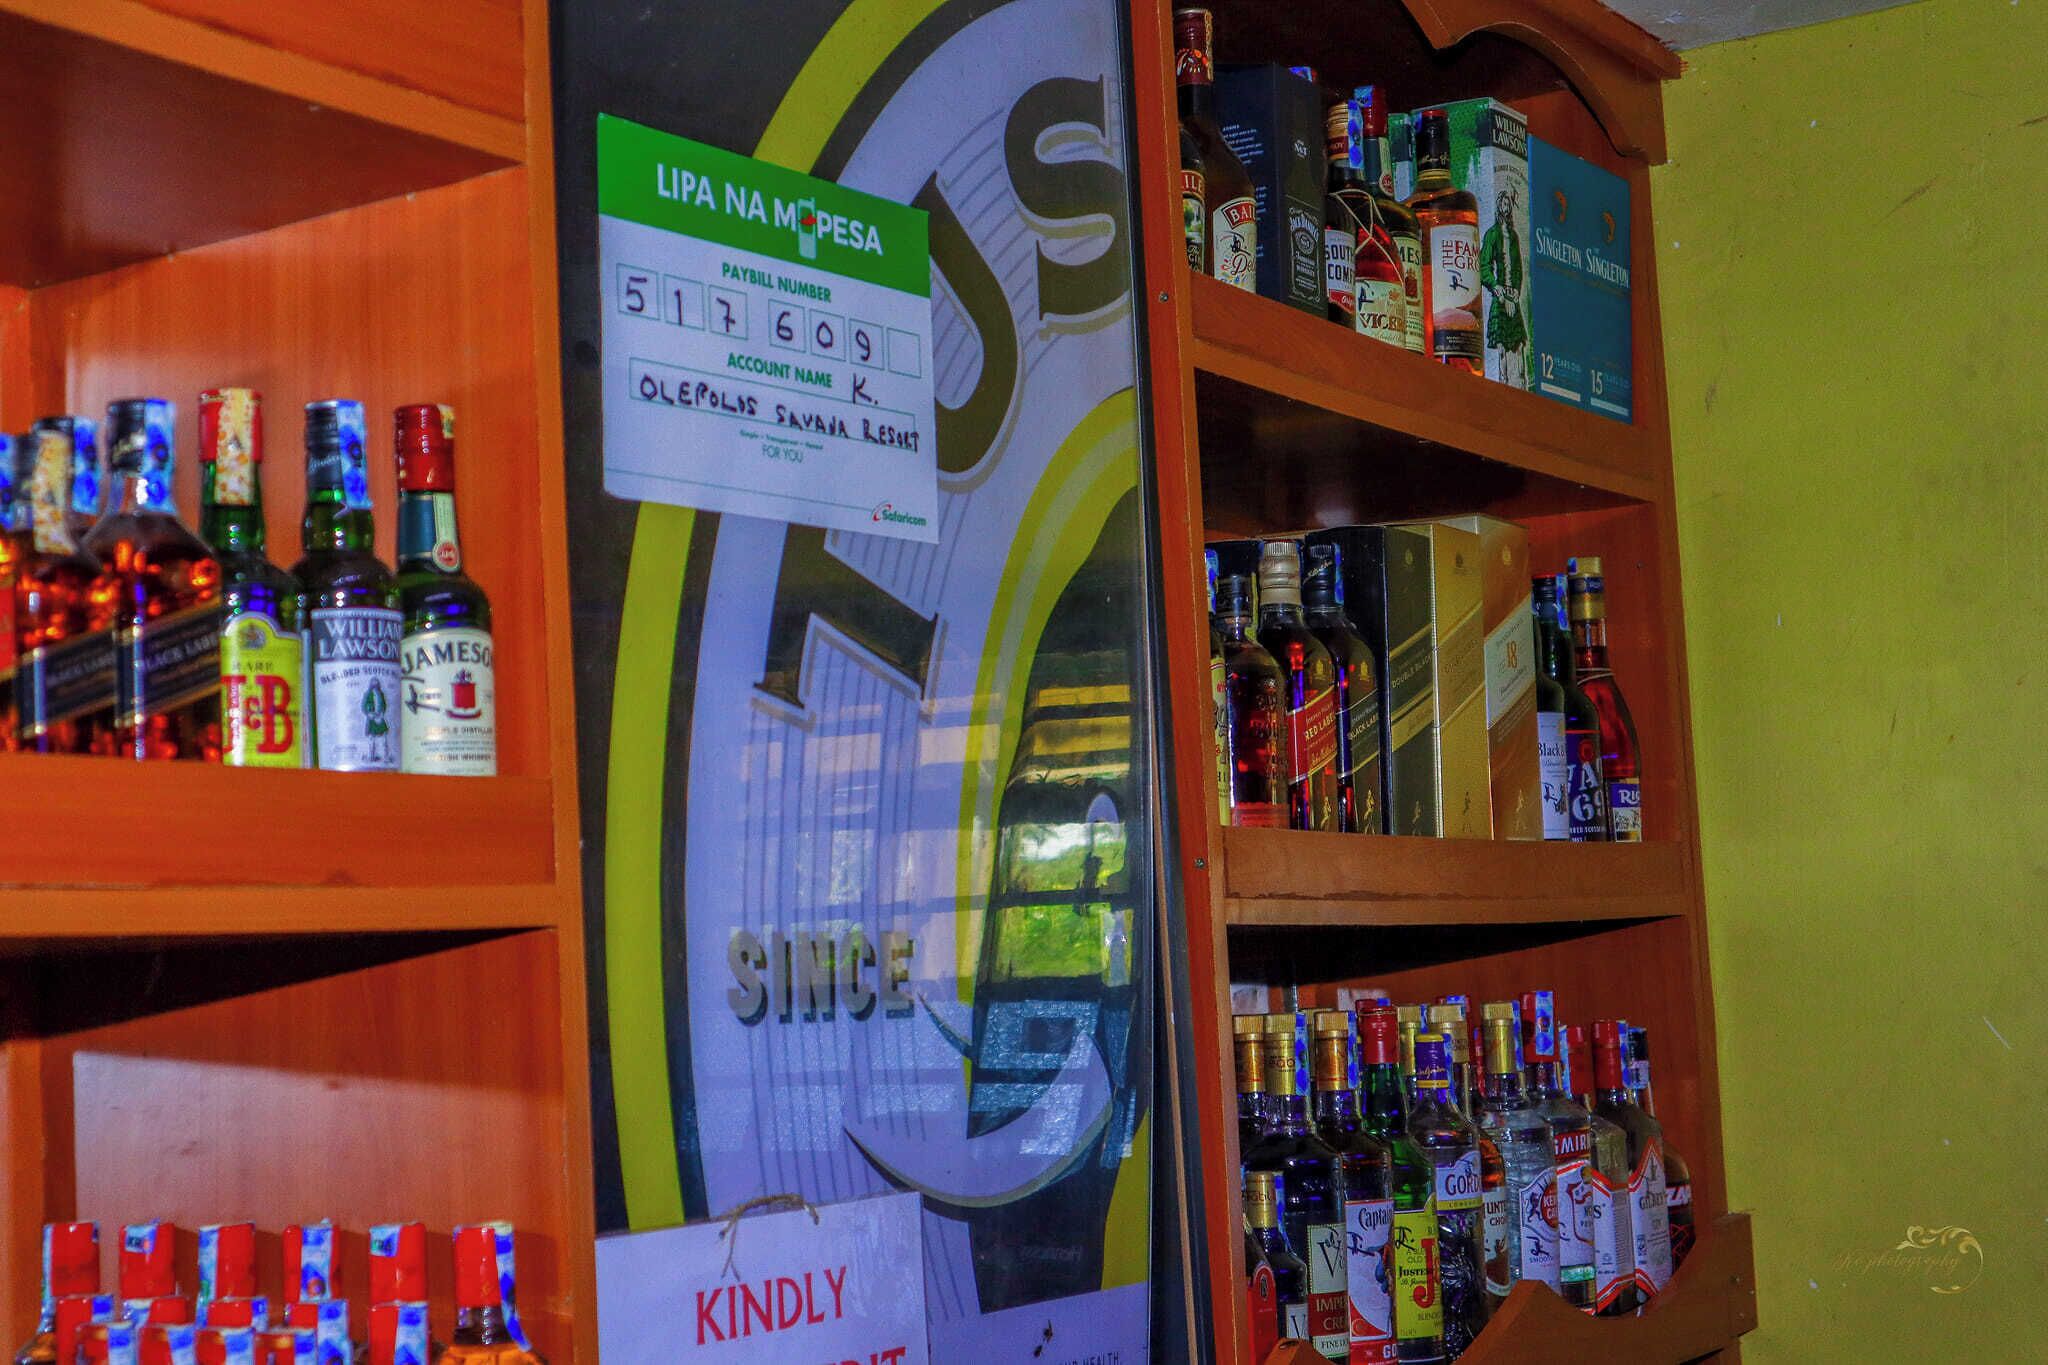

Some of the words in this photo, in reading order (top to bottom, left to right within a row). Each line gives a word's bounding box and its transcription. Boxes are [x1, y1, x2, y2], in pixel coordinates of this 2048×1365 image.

[1494, 114, 1526, 142] WILLIAM
[656, 163, 716, 211] LIPA
[725, 182, 768, 225] NA
[1442, 239, 1454, 269] THE
[721, 262, 774, 289] PAYBILL
[777, 276, 832, 303] NUMBER
[727, 352, 790, 379] ACCOUNT
[794, 368, 833, 389] NAME
[1540, 352, 1554, 380] 12
[1590, 369, 1603, 395] 15
[761, 444, 783, 461] FOR
[784, 448, 804, 464] YOU
[882, 509, 927, 528] Safaricom
[1506, 640, 1518, 669] 18
[1304, 725, 1319, 742] RED
[727, 930, 916, 1028] SINCE
[696, 1265, 848, 1346] KINDLY
